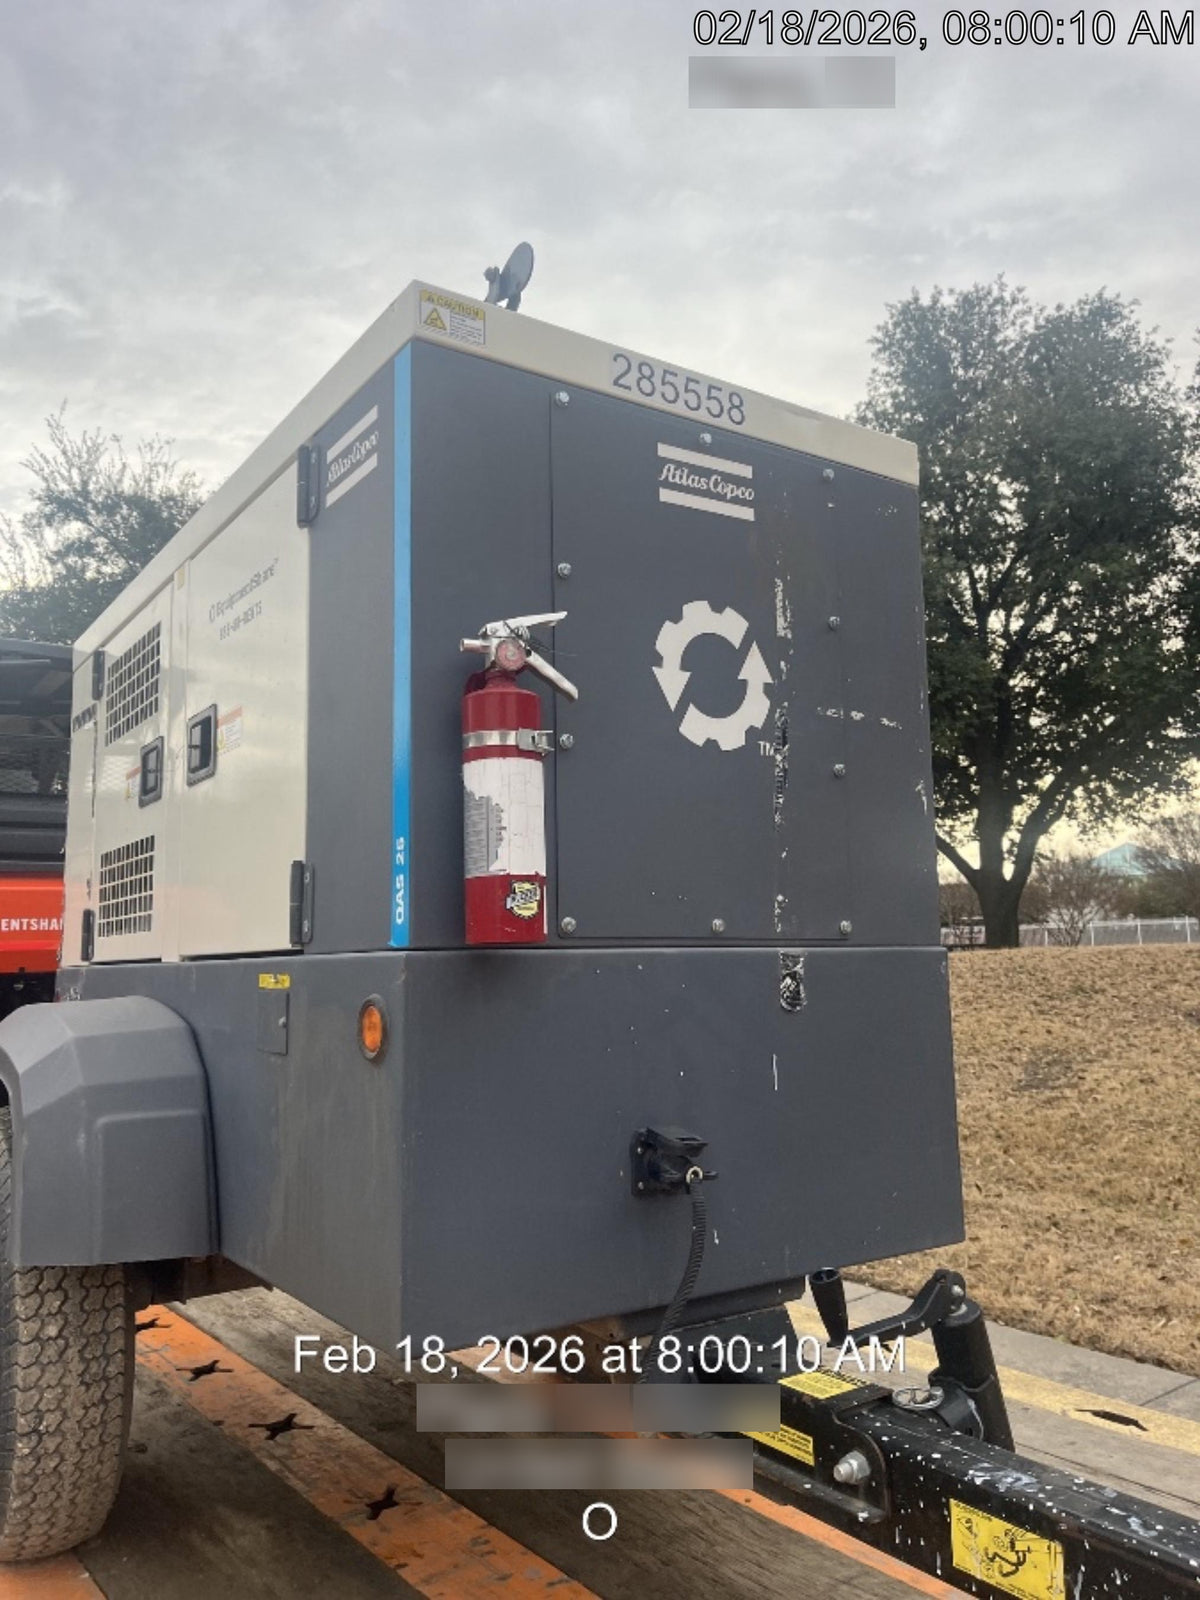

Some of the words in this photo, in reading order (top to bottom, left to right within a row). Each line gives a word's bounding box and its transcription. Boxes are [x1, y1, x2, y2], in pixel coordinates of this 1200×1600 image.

[612, 352, 746, 426] 285558
[659, 463, 709, 490] Atlas
[709, 474, 755, 501] Copco
[396, 837, 405, 866] 25
[396, 874, 405, 925] QAS
[0, 917, 63, 932] ENTSHA
